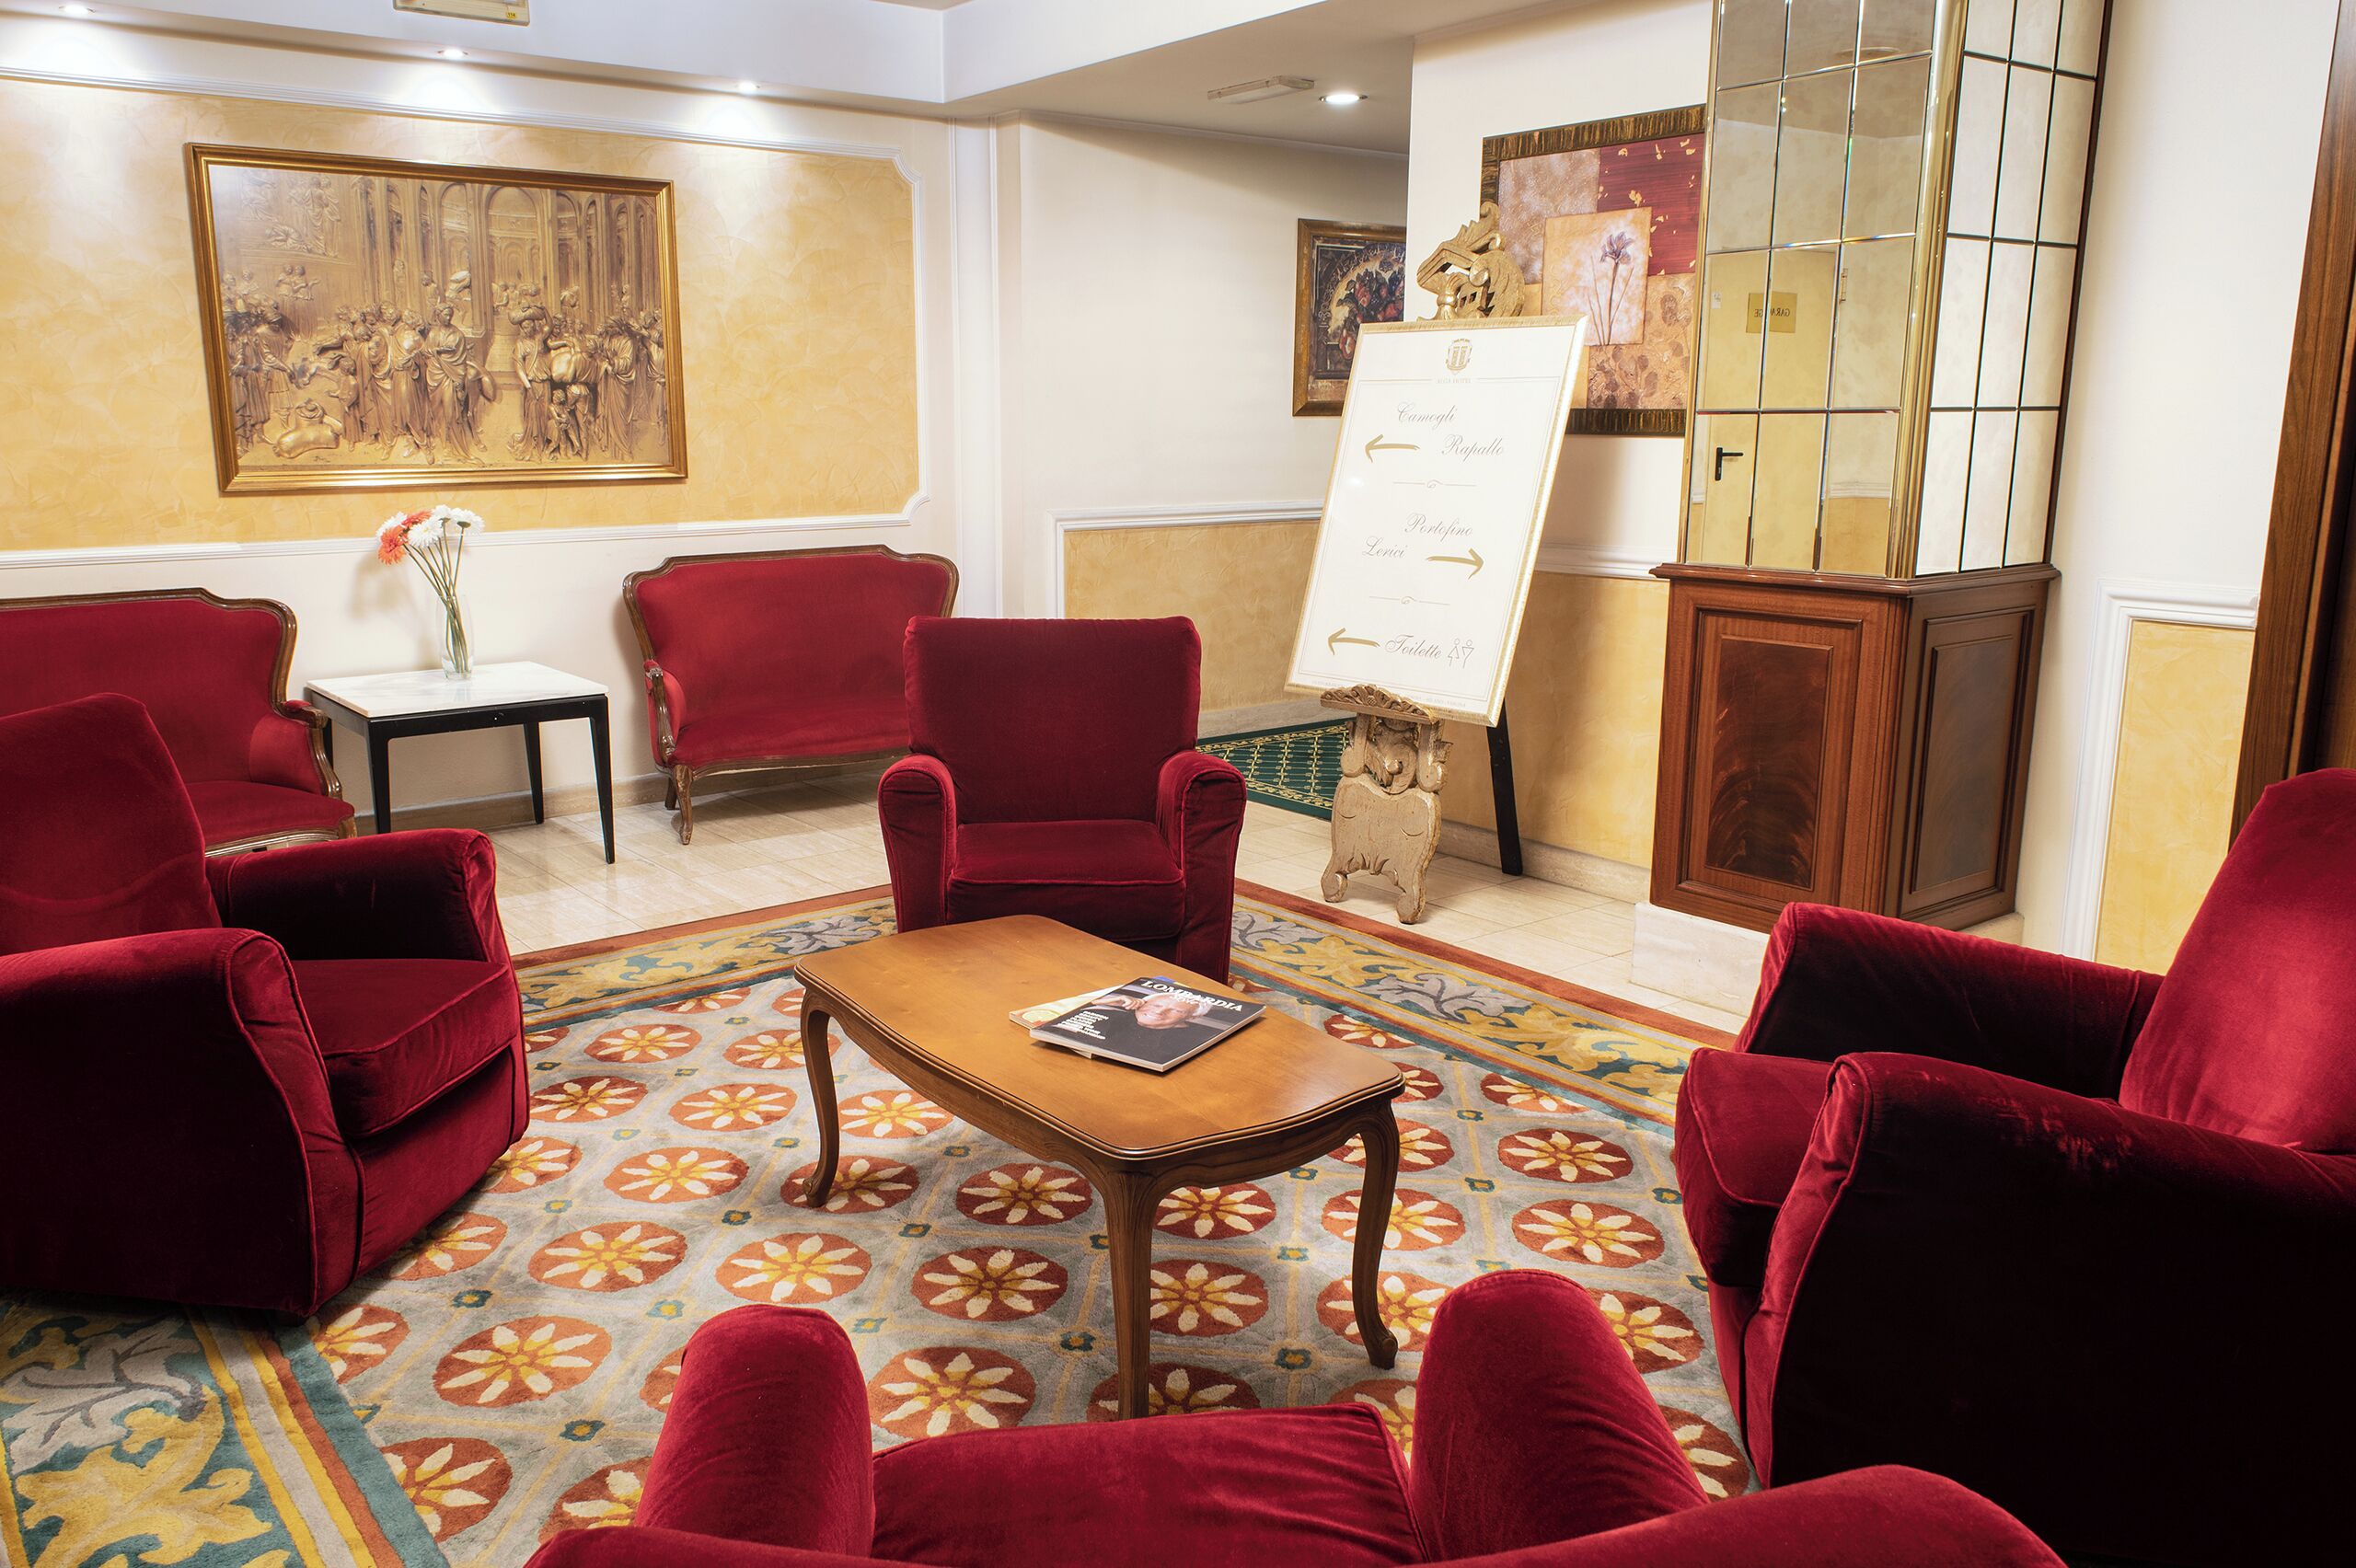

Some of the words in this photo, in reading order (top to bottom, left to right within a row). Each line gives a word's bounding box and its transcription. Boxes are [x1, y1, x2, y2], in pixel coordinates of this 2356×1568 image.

[1396, 402, 1459, 430] Camogli
[1441, 433, 1504, 462] Rapallo
[1404, 513, 1473, 542] Portofino
[1362, 536, 1408, 559] Lerici
[1384, 634, 1442, 660] Toilette
[1140, 980, 1243, 1012] LOMBARDIA
